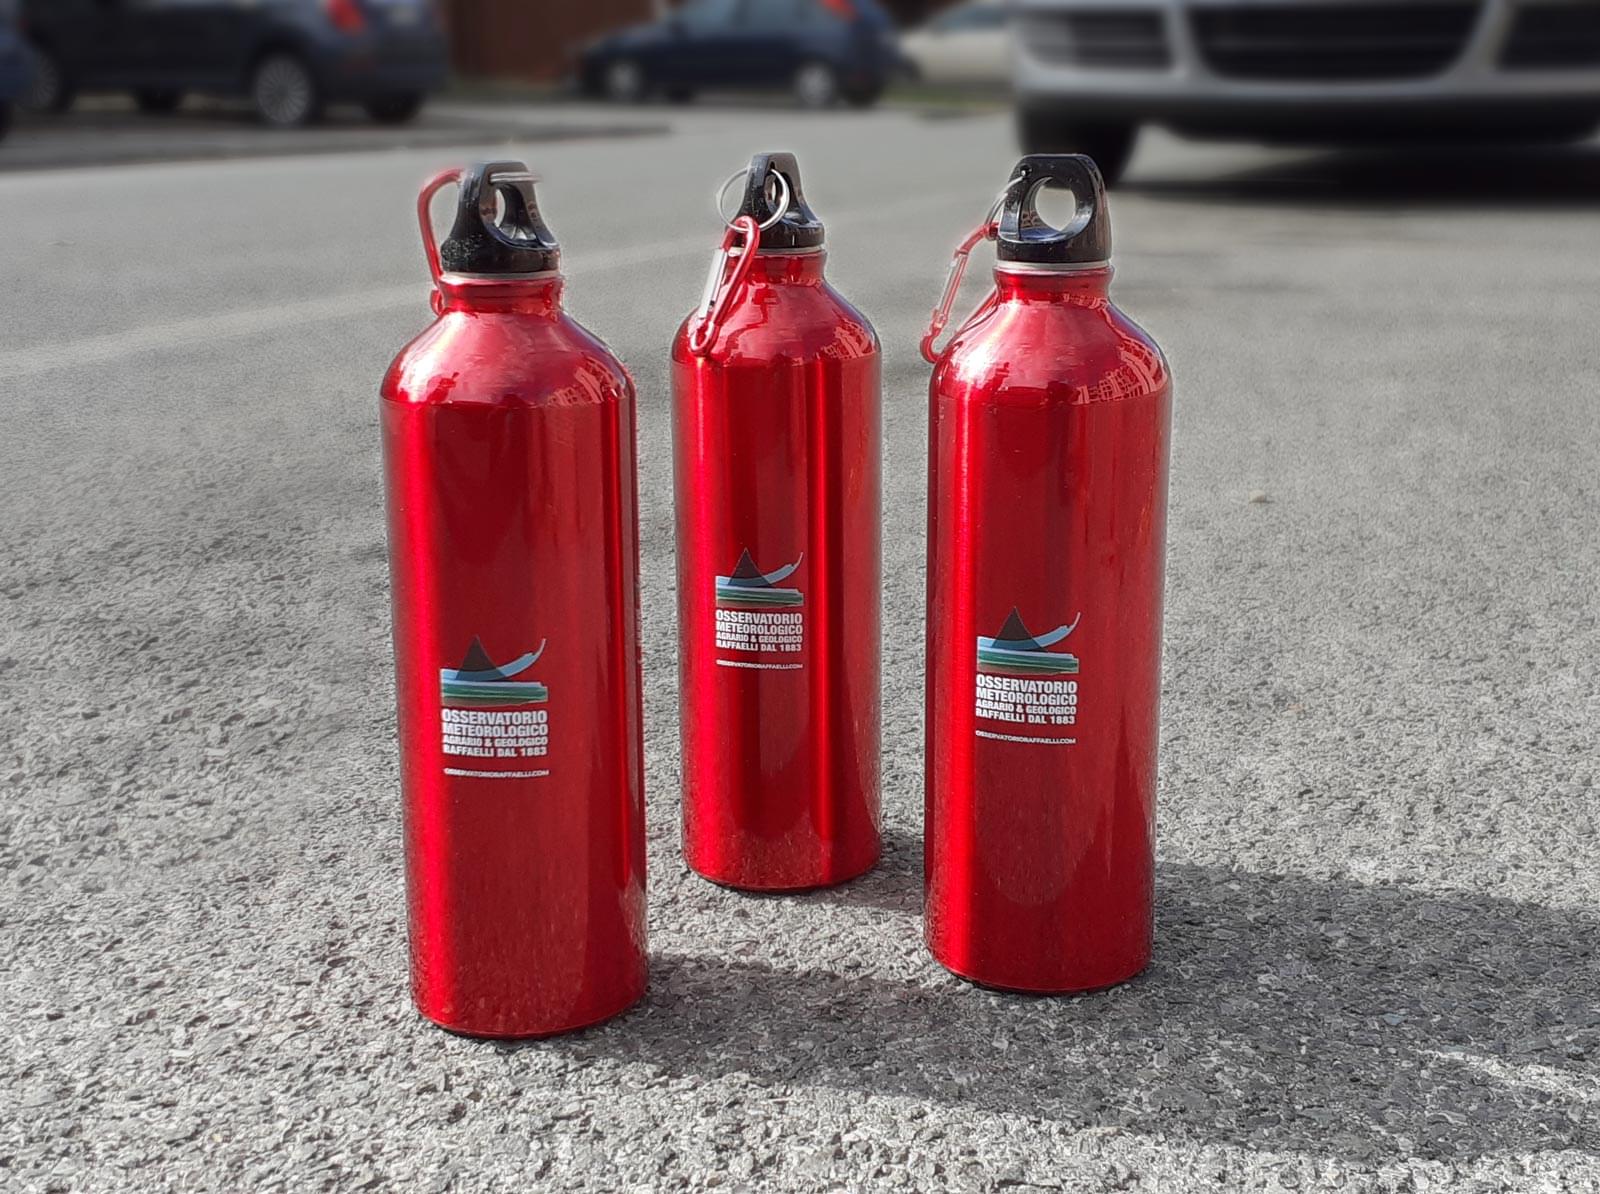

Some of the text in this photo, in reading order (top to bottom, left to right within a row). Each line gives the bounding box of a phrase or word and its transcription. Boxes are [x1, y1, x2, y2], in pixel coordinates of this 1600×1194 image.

[716, 610, 803, 624] OSSERVATORIO
[715, 621, 803, 635] METEOROLOGICO
[716, 632, 749, 642] AGRARIO
[758, 635, 803, 643] GEOLOGICO
[715, 639, 758, 651] RAFFAELLI
[780, 643, 802, 651] 1883
[976, 674, 1077, 693] OSSERVATORIO
[976, 686, 1077, 705] METEOROLOGICO
[975, 699, 1077, 714] AGRARIO & GEOLOGICO
[442, 708, 548, 725] OSSERVATORIO
[975, 708, 1075, 724] RAFFAELLI DAL 1883
[442, 722, 548, 737] METEOROLOGICO
[443, 734, 548, 747] AGRARIO & GEOLOGICO
[443, 743, 547, 757] RAFFAELLI DAL 1883
